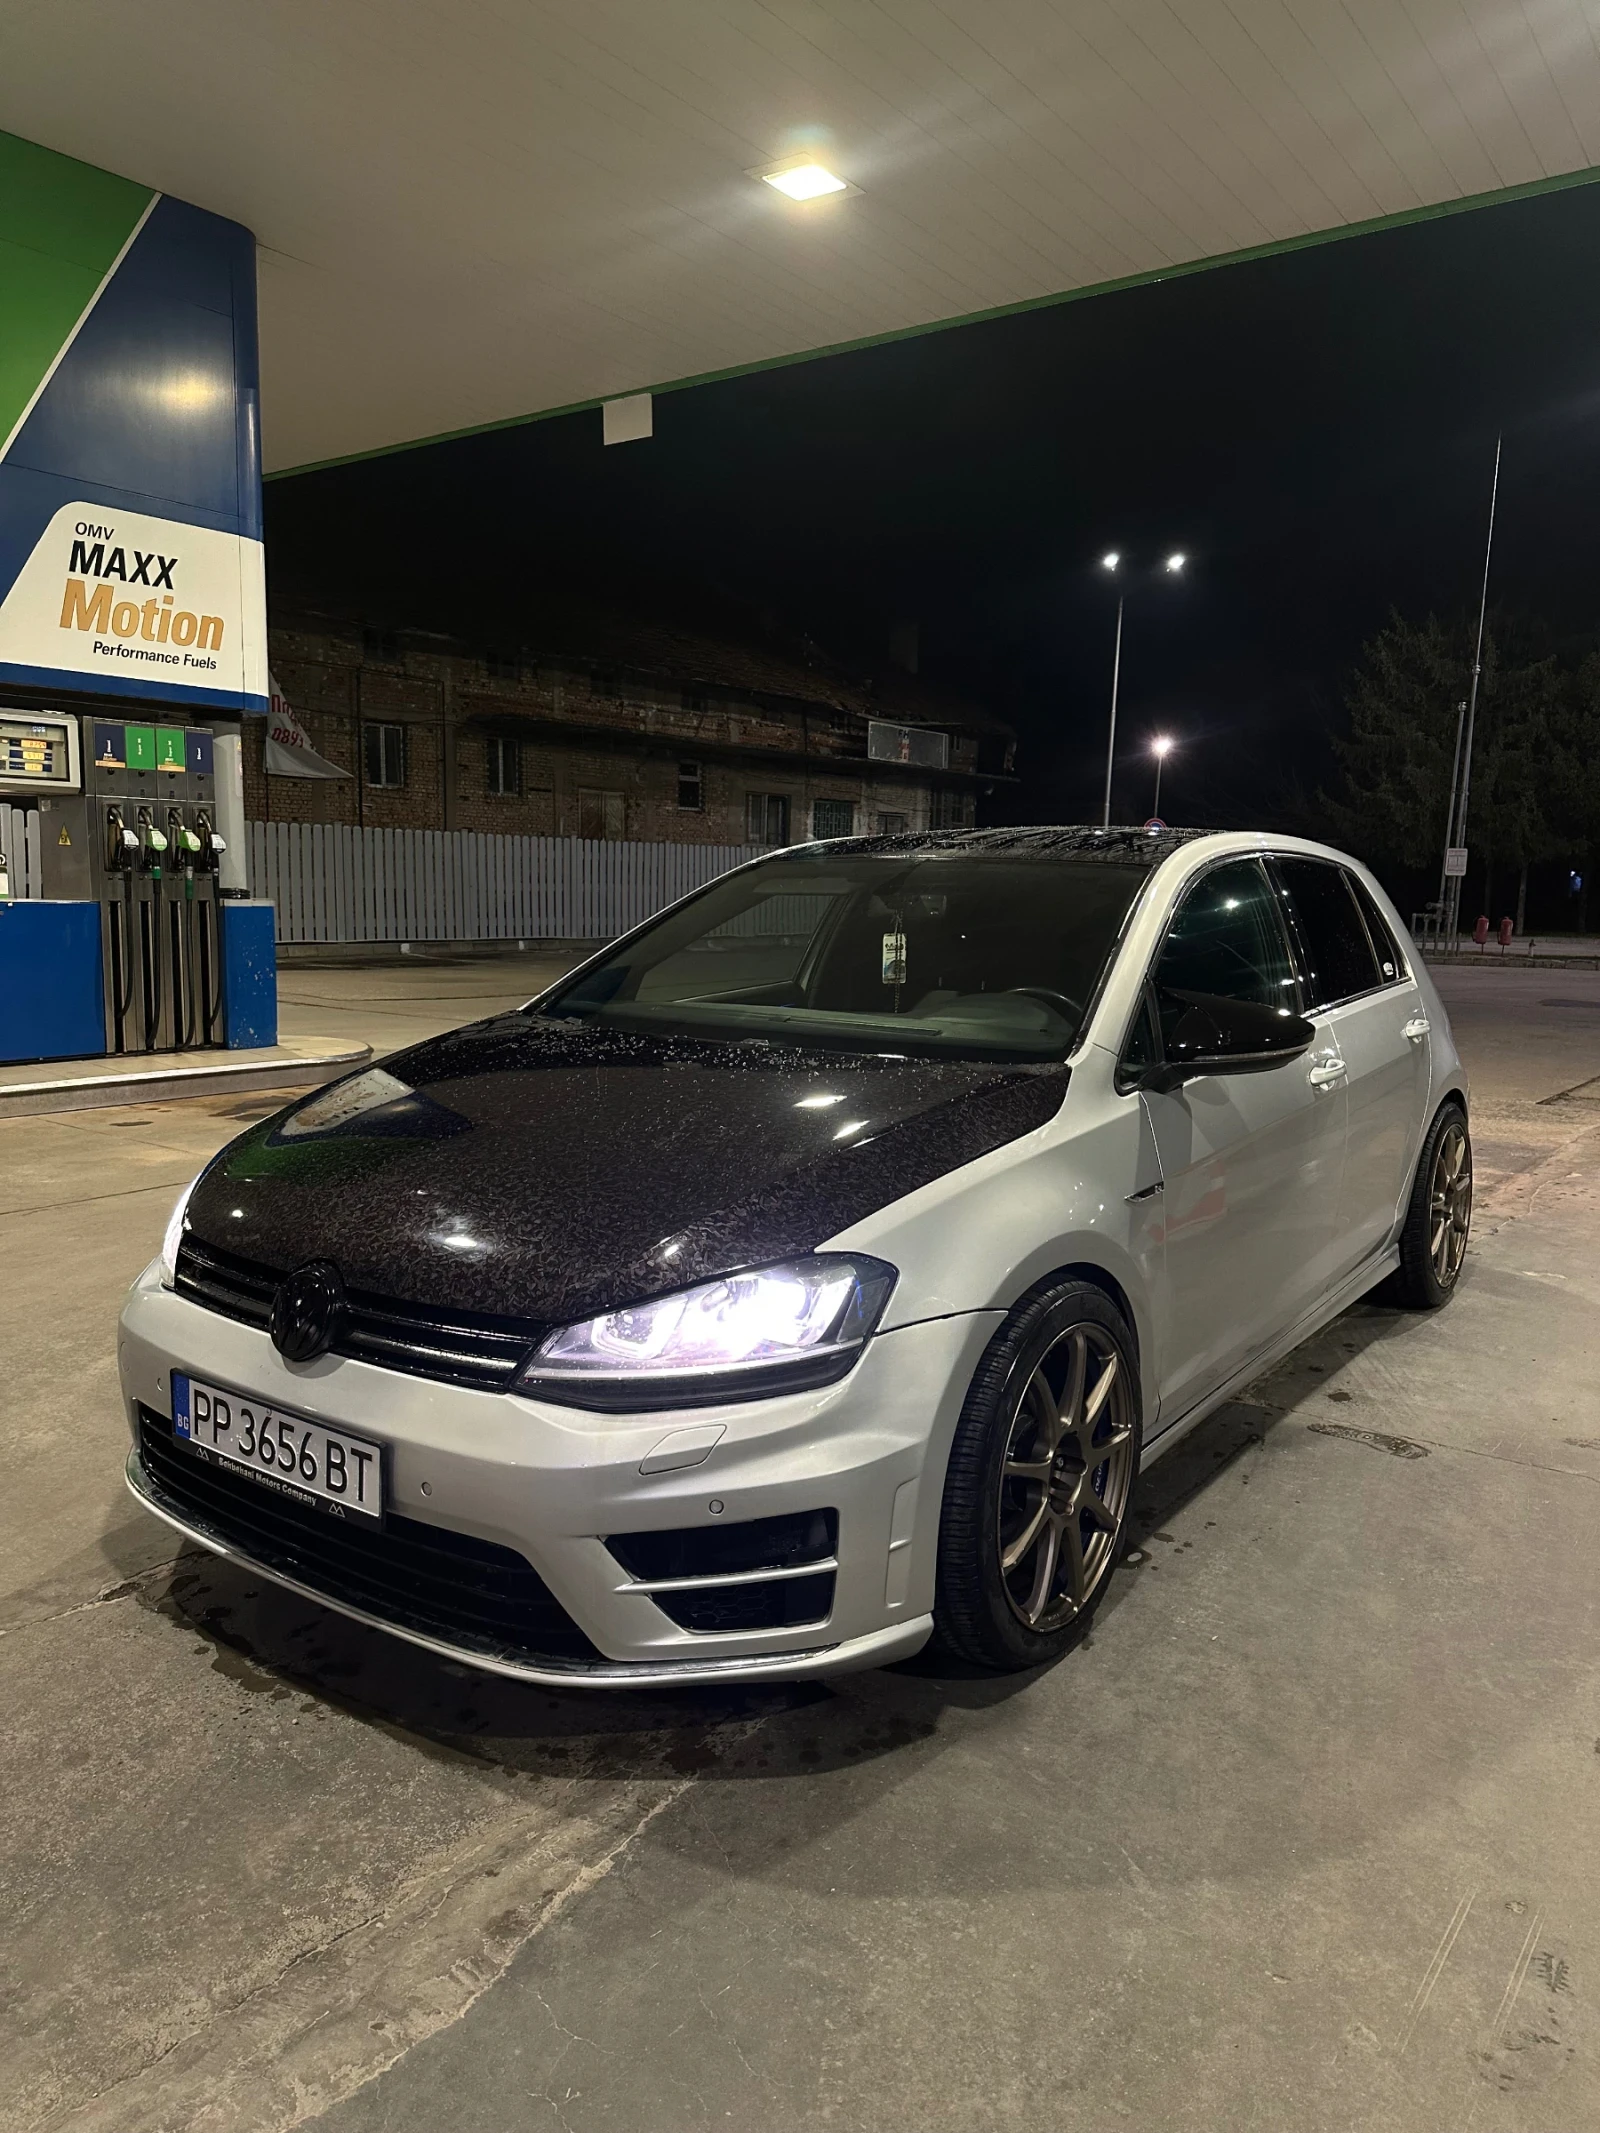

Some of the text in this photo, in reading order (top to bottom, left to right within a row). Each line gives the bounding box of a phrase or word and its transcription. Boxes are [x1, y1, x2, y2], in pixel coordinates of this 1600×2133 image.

[75, 522, 114, 540] OMV
[69, 540, 178, 590] MAXX
[60, 578, 224, 651] Motion
[93, 641, 217, 670] Performance Fuels
[177, 1413, 189, 1431] BG
[193, 1388, 373, 1503] PP 3656 BT
[255, 1473, 281, 1491] Motors
[281, 1485, 317, 1506] Company
